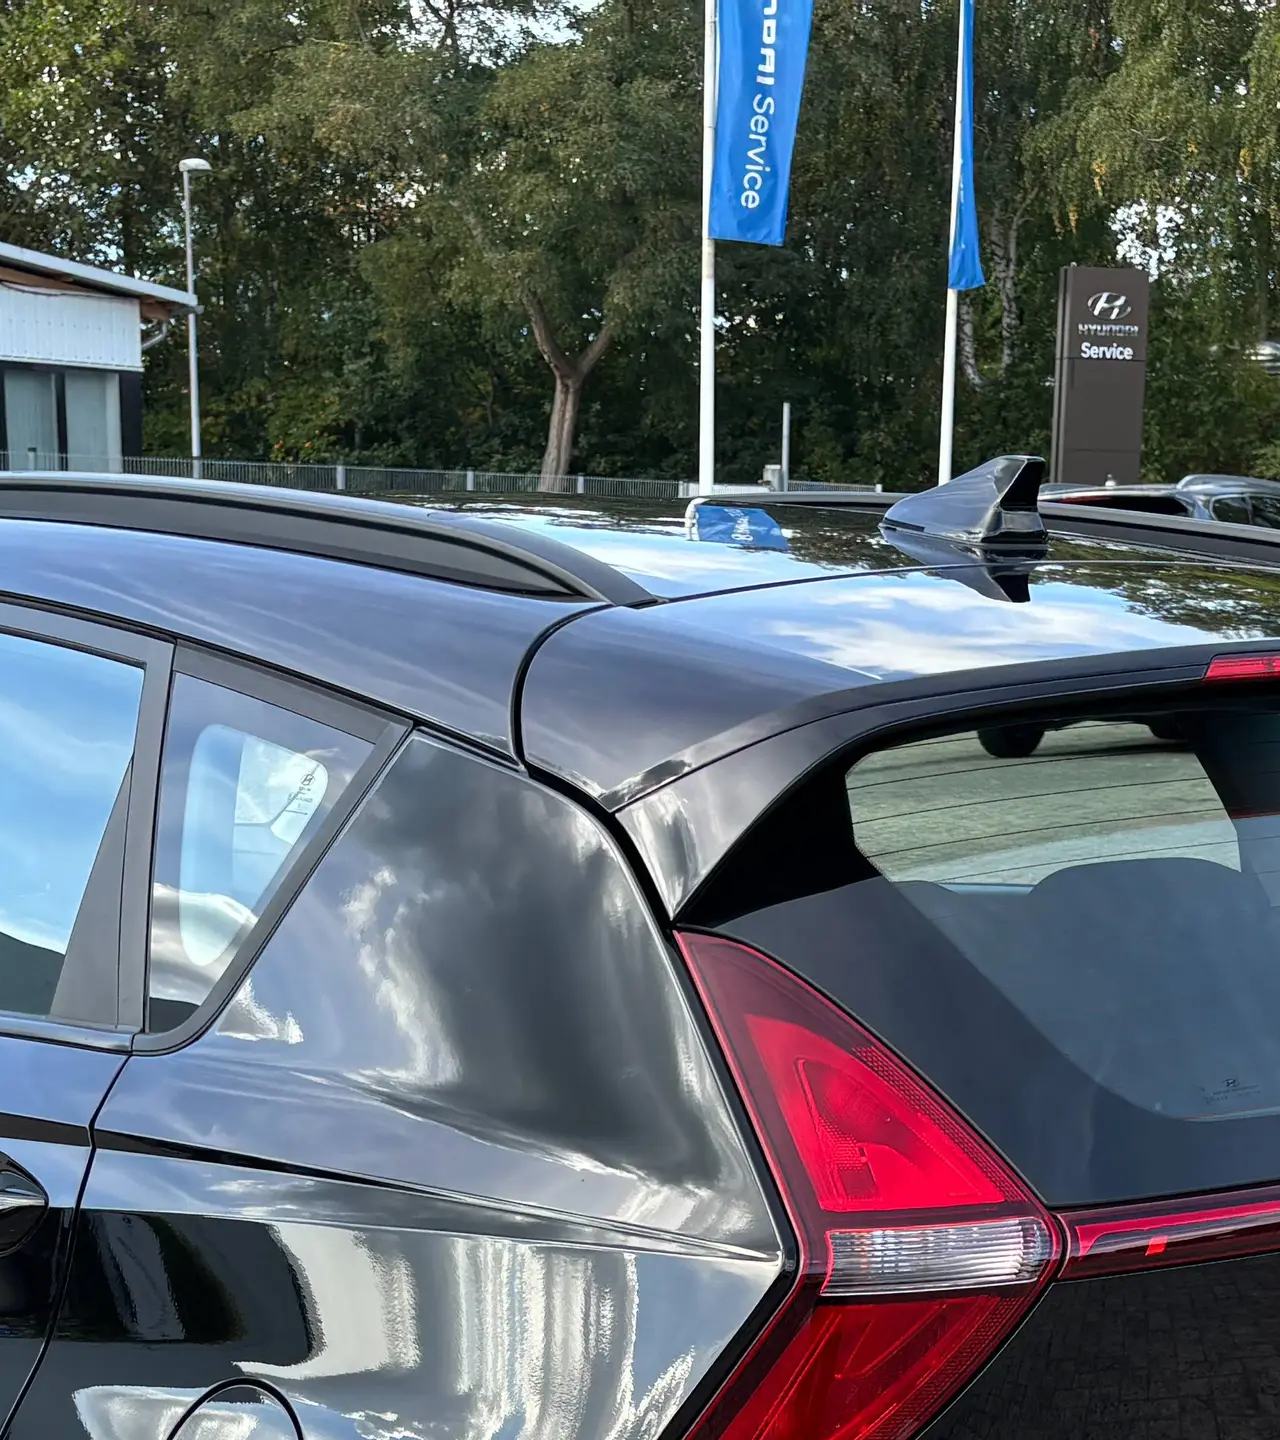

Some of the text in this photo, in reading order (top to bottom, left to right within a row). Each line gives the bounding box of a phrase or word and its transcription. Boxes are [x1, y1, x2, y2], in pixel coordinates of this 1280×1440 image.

[741, 93, 775, 209] Service
[1078, 323, 1139, 337] HYUNDAI
[1081, 341, 1134, 360] Service
